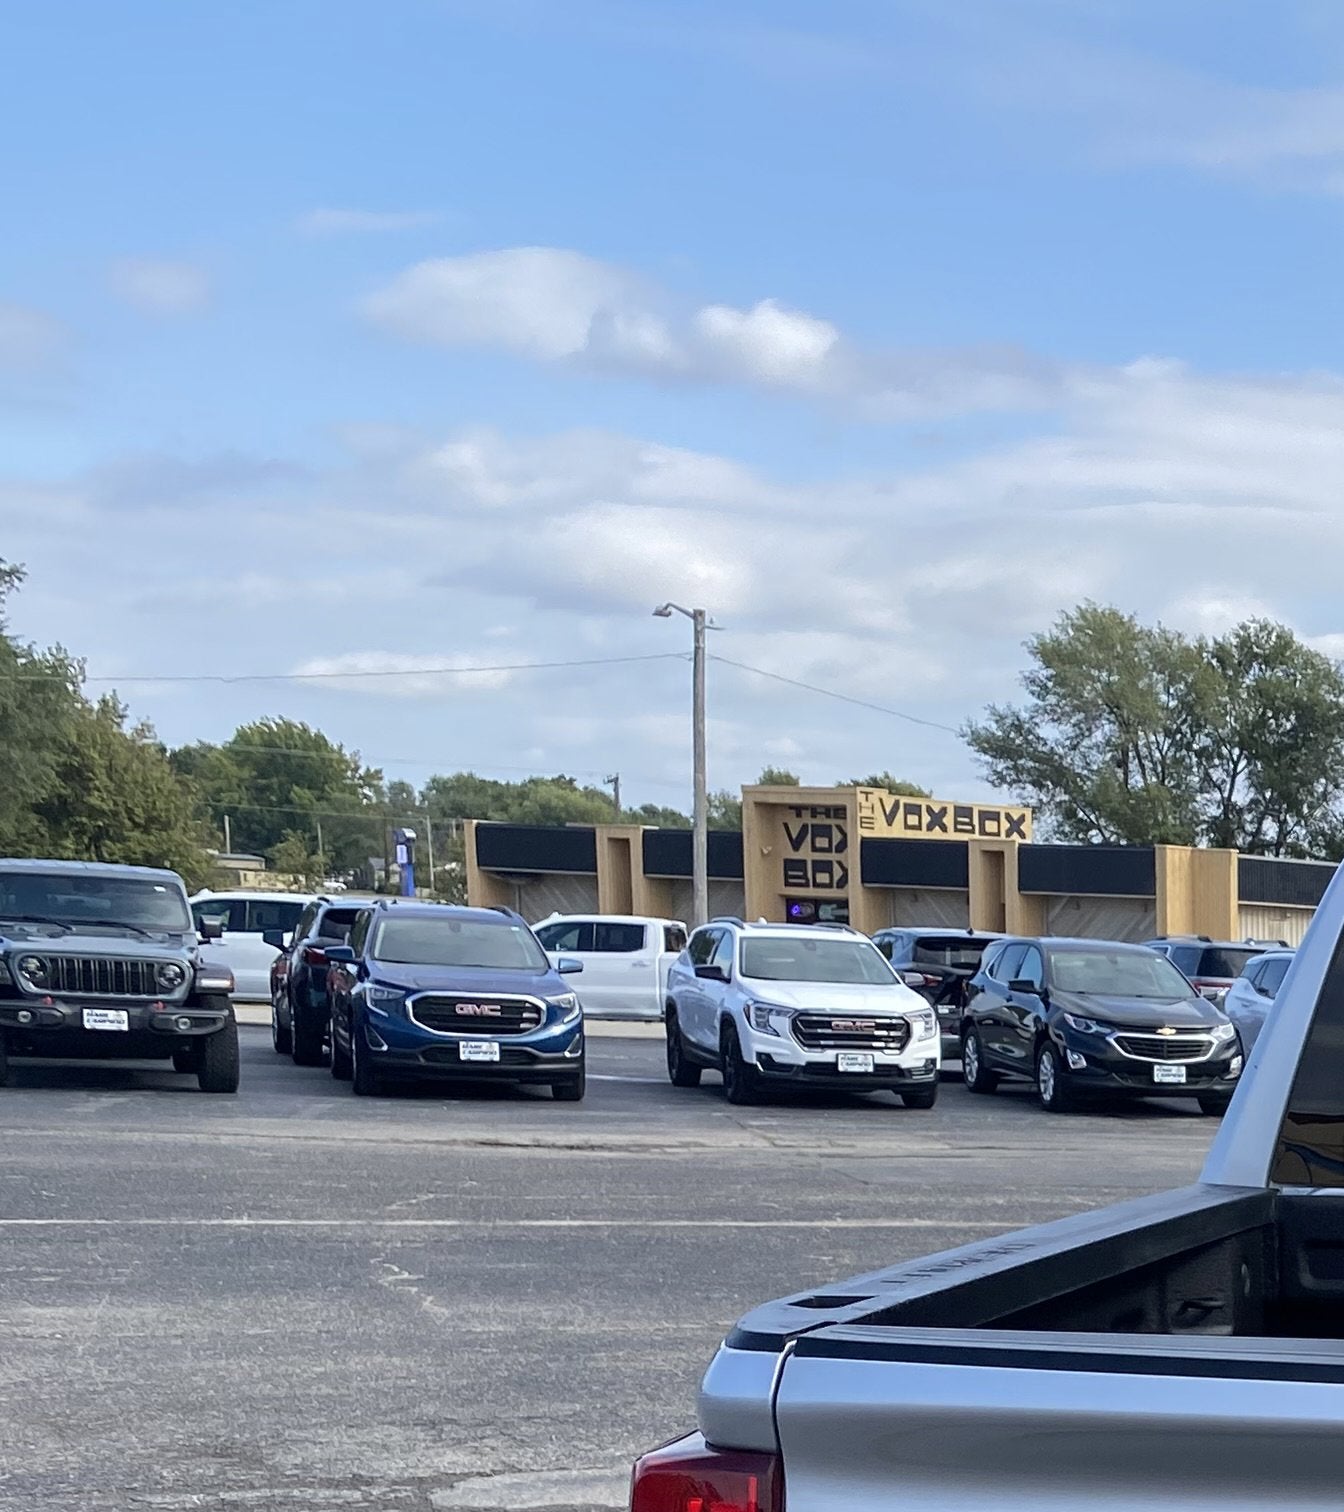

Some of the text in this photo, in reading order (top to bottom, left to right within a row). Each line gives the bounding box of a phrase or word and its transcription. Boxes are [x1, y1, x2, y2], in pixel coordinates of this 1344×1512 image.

[788, 805, 848, 820] THE
[860, 791, 875, 830] THE
[455, 1003, 502, 1016] GMC
